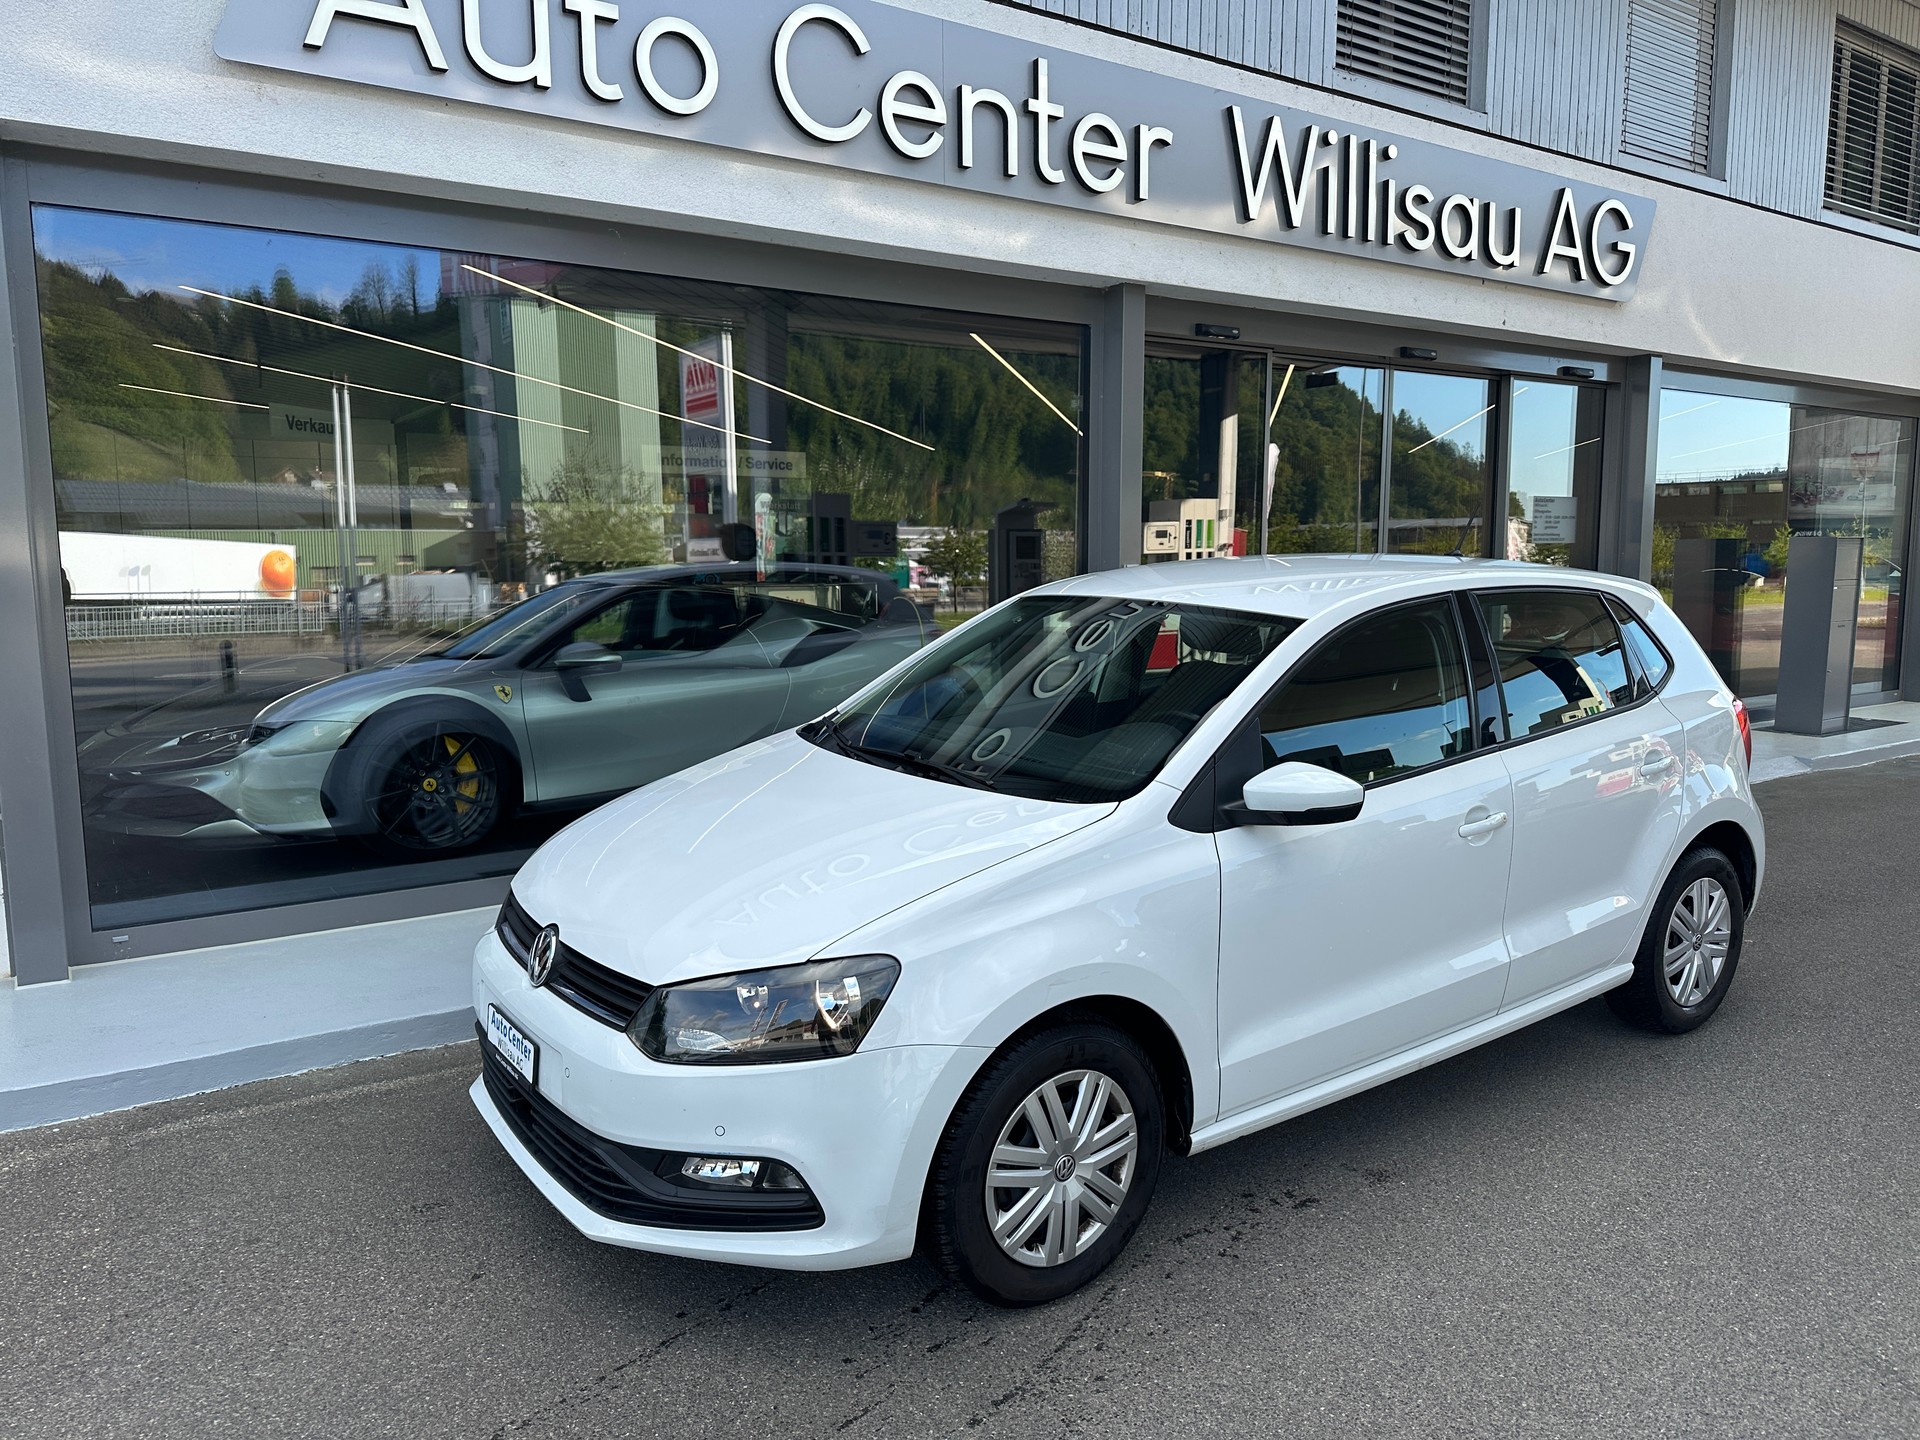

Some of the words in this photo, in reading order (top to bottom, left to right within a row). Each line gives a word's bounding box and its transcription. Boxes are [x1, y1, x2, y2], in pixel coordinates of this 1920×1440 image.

[771, 3, 1174, 202] Center
[1227, 105, 1521, 270] Willisau
[1538, 186, 1636, 287] AG
[285, 413, 335, 436] Verkau
[657, 452, 728, 470] Informatio
[745, 455, 794, 472] Service
[497, 1034, 516, 1064] Willisau
[515, 1055, 525, 1072] AG
